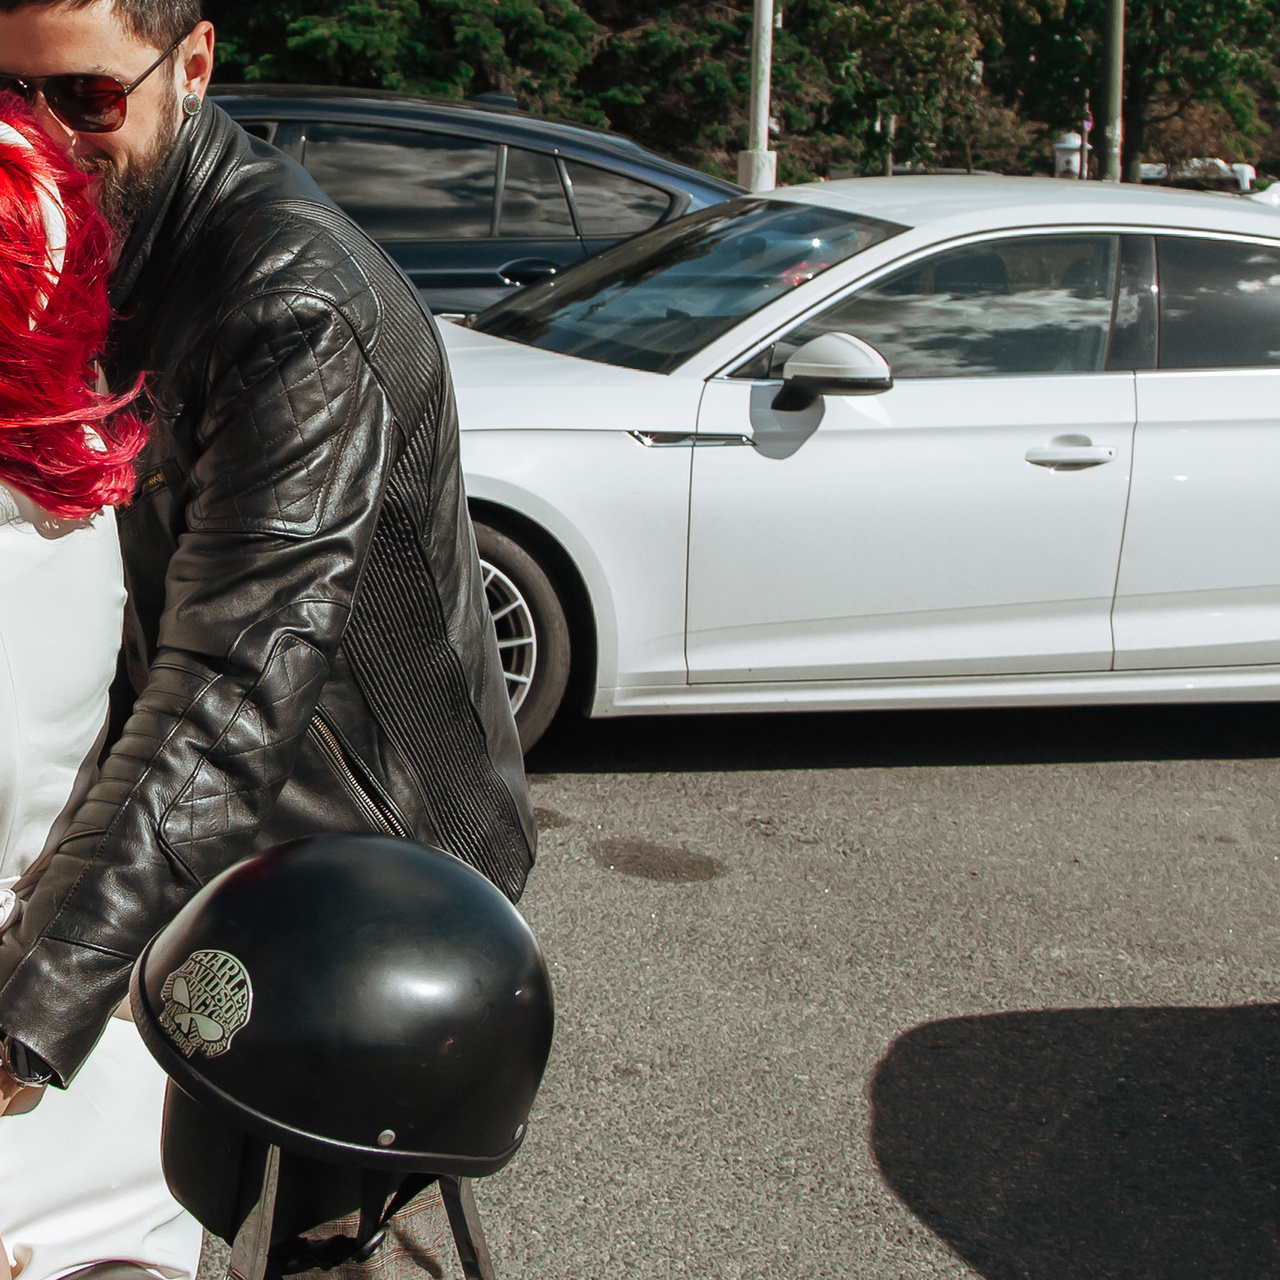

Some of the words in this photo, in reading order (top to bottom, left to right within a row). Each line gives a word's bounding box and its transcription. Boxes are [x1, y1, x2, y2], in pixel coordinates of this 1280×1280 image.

[175, 971, 231, 1038] TORCYCLE
[181, 959, 241, 1033] DAVIDSON
[192, 952, 249, 1024] HARLEY
